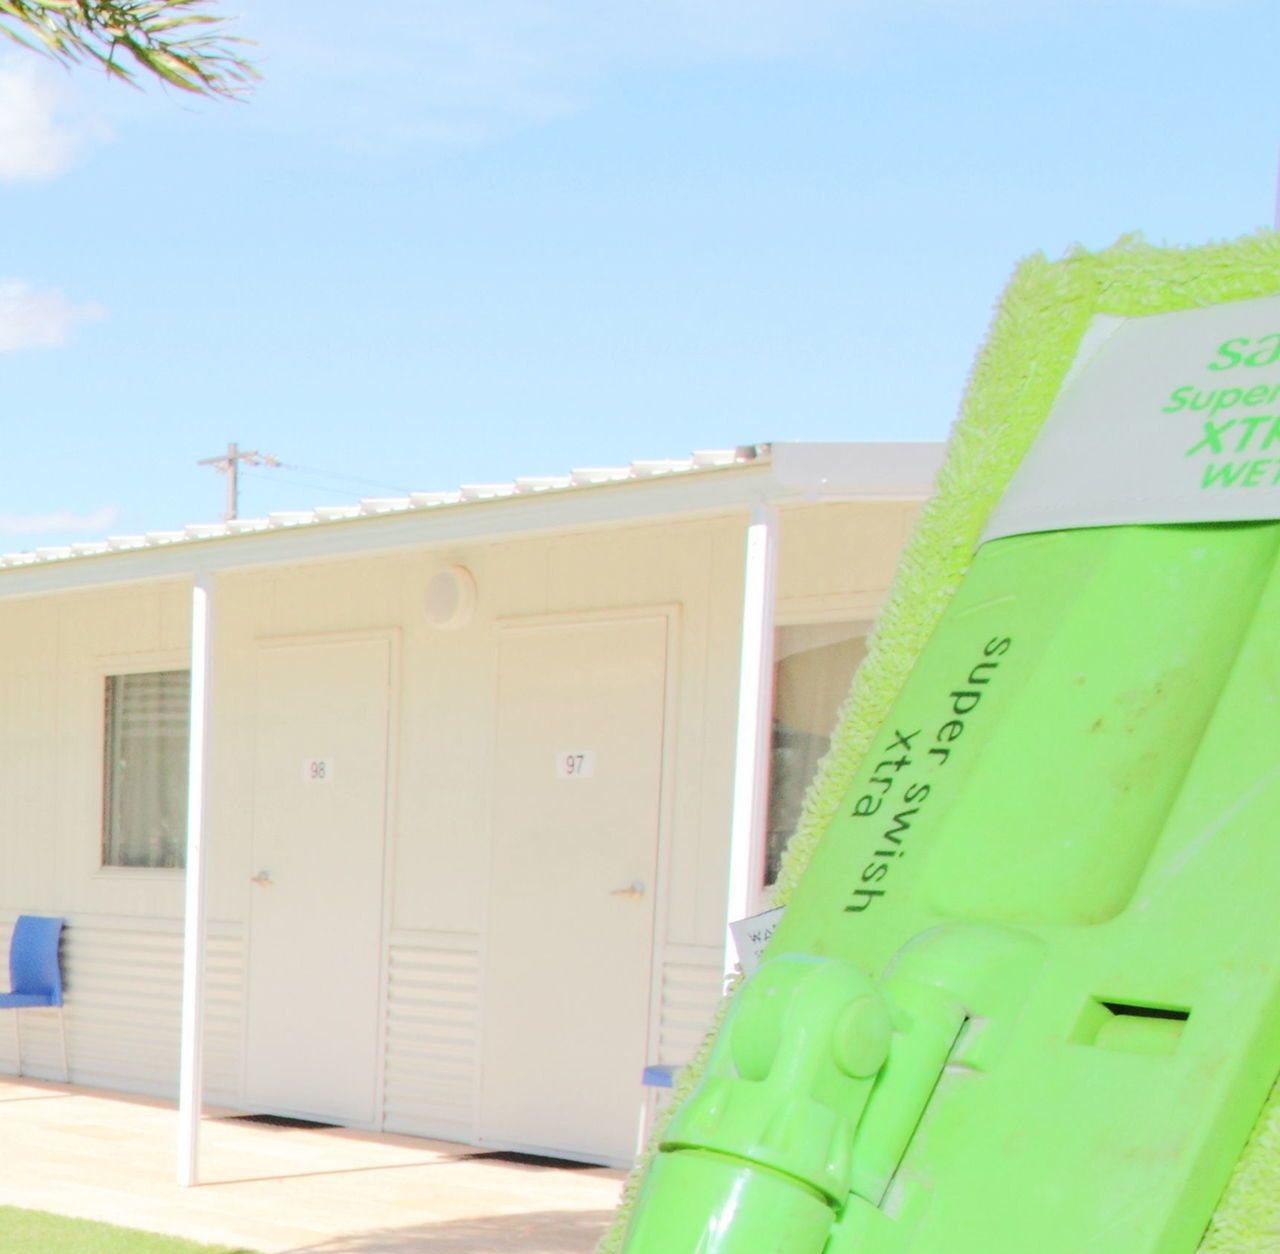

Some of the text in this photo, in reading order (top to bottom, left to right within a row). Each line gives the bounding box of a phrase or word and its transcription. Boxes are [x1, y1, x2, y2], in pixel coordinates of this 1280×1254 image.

[565, 754, 584, 775] 97
[844, 636, 1011, 912] super swish
[851, 729, 922, 816] xtra
